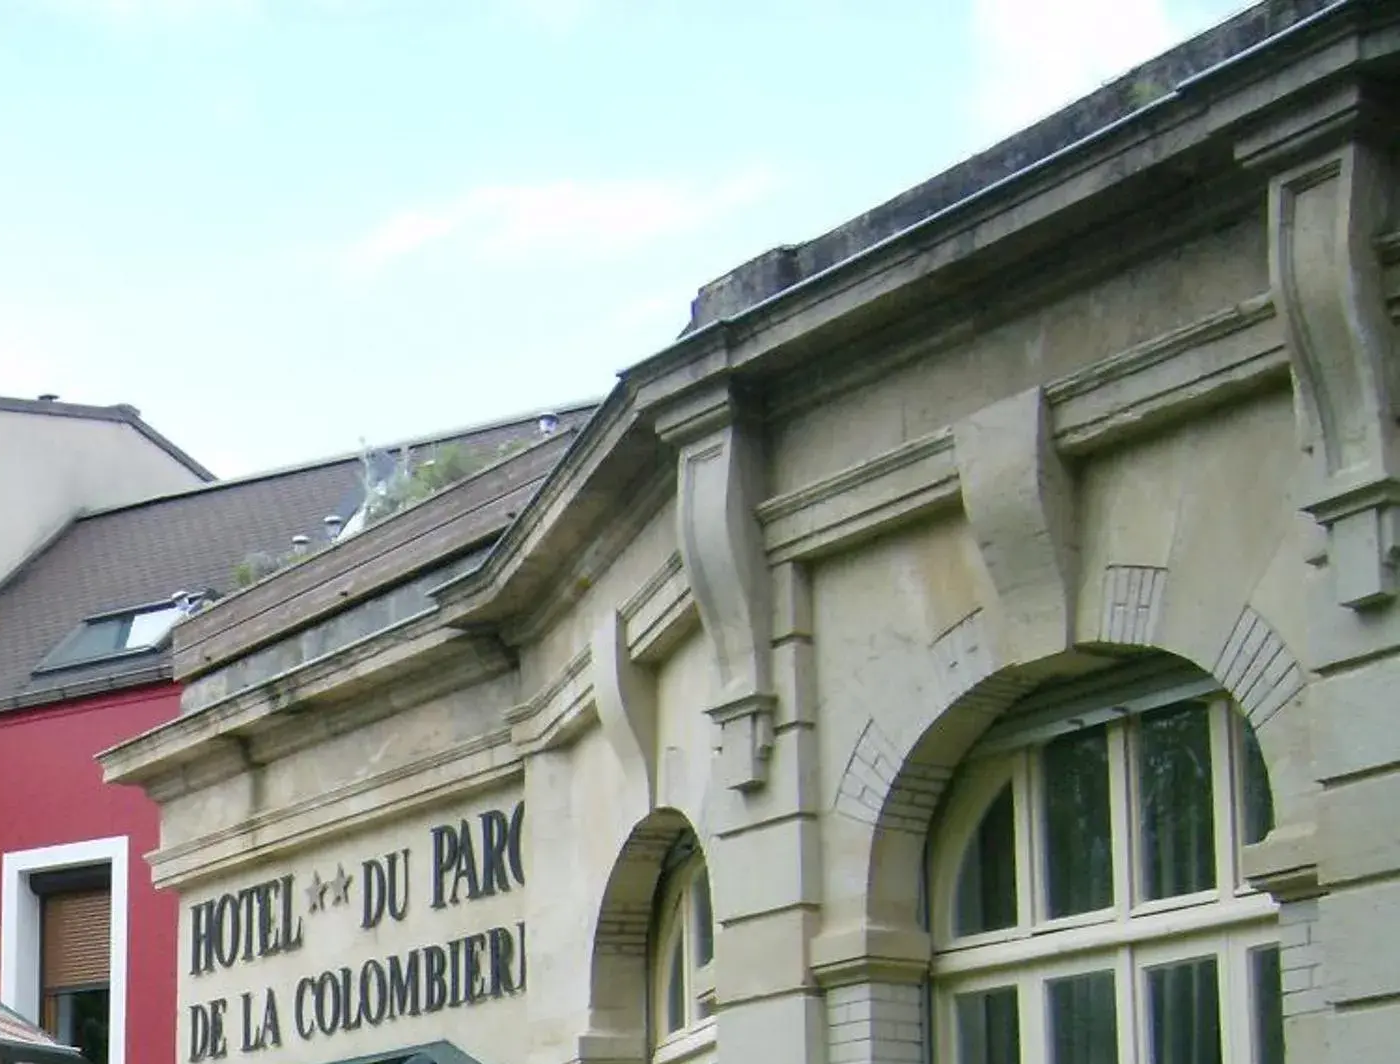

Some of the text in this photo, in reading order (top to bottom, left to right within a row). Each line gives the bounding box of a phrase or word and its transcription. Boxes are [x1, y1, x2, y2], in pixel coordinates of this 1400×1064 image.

[189, 873, 303, 976] HOTEL
[360, 848, 412, 929] DU
[188, 998, 228, 1064] DE
[241, 987, 282, 1053] LA
